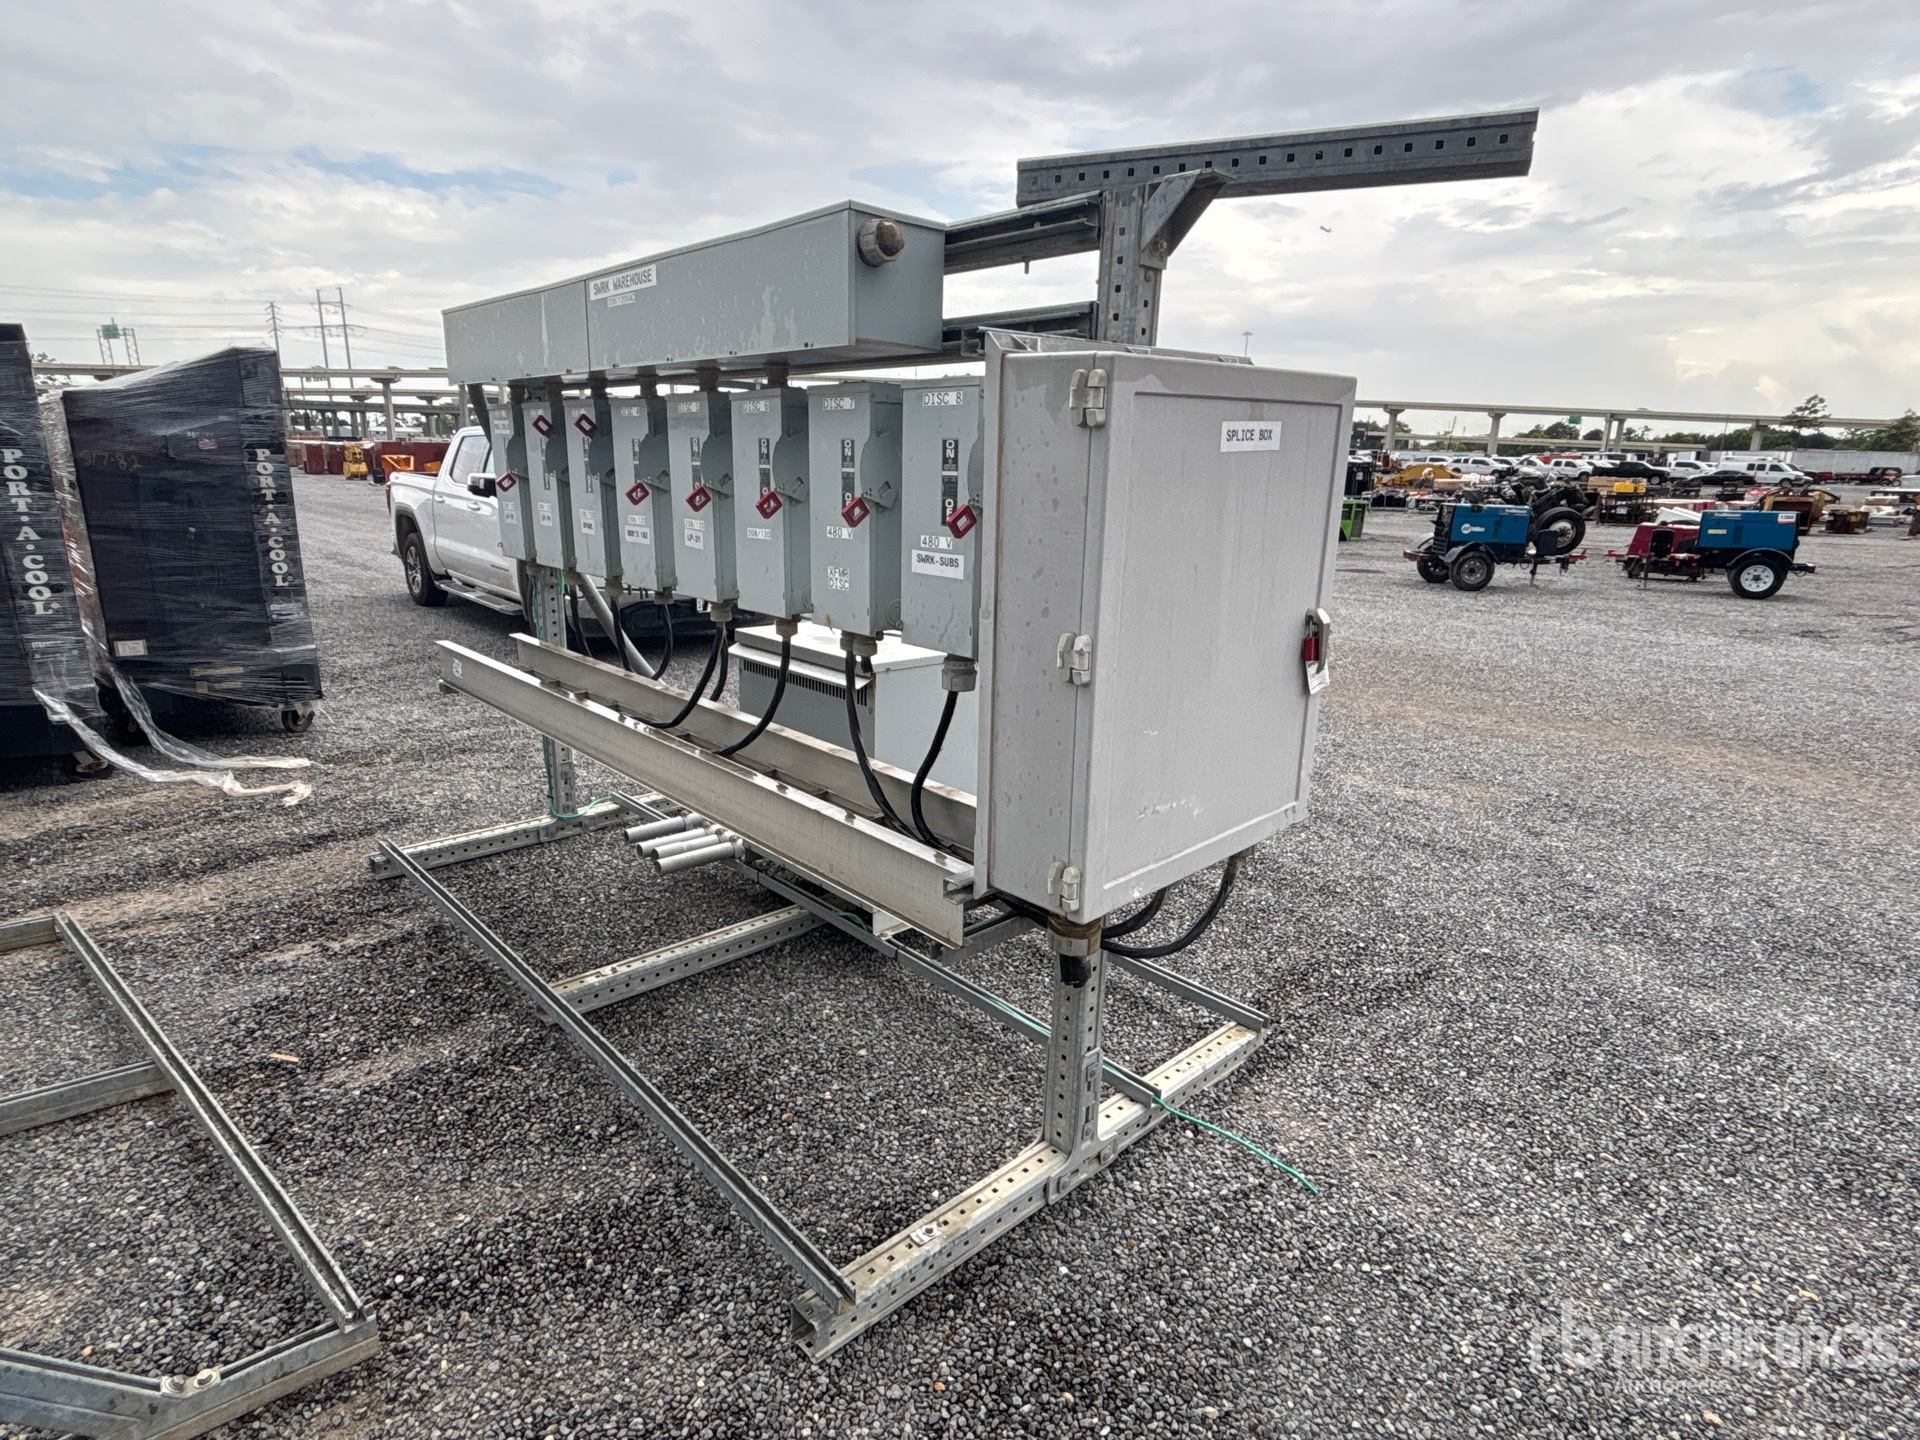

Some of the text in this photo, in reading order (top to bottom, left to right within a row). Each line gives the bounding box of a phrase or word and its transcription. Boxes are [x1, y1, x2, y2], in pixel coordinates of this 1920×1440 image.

[593, 269, 652, 295] SWRK WAREHOUSE
[823, 398, 854, 409] DISC 7
[923, 391, 962, 405] DISC 8
[743, 402, 760, 413] DISC
[1226, 429, 1273, 442] SPLICE BOX
[760, 438, 768, 454] ON
[844, 440, 852, 456] ON
[946, 440, 955, 458] ON
[747, 529, 771, 539] 208/120
[828, 527, 853, 539] 480 V
[922, 536, 952, 548] 480 V
[916, 554, 959, 568] SWRK-SUBS
[829, 567, 848, 578] XFMR
[829, 578, 849, 590] DISC
